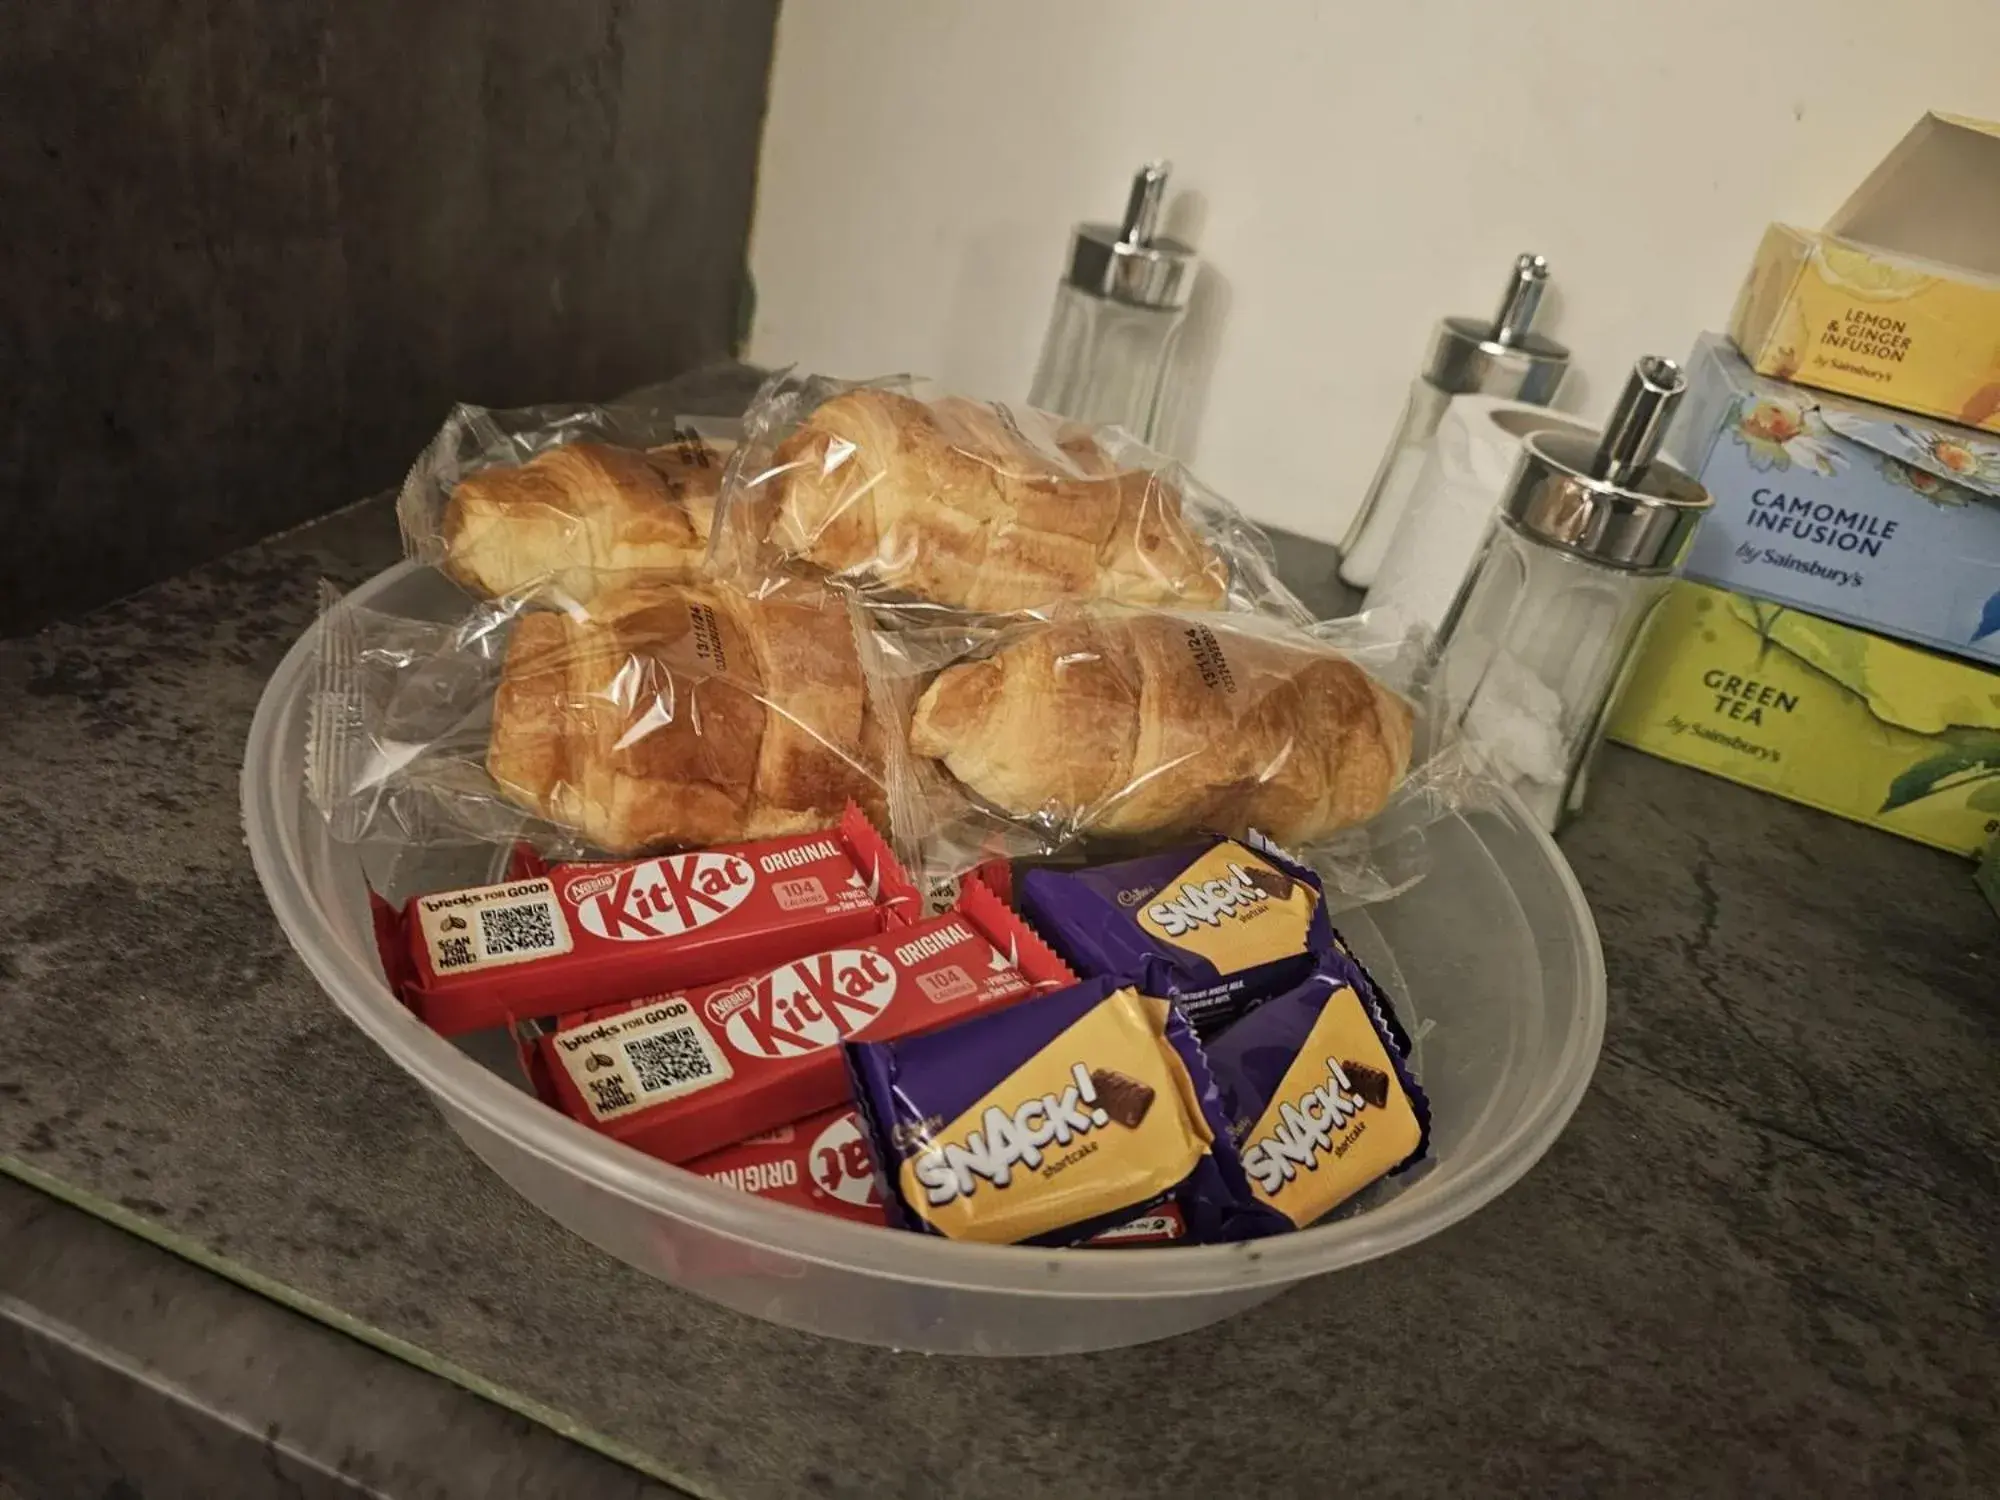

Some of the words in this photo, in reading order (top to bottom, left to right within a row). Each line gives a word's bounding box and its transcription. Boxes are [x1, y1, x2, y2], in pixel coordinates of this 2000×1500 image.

[1827, 319, 1841, 333] &
[1846, 323, 1912, 350] GINGER
[1844, 307, 1907, 334] LEMON
[1820, 331, 1905, 363] INFUSION
[1746, 508, 1884, 558] INFUSION
[1751, 487, 1898, 540] CAMOMILE
[1735, 540, 1761, 565] by
[1764, 548, 1865, 588] Sainsbury's
[1184, 628, 1219, 689] 13/11/24
[1702, 668, 1799, 713] GREEN
[1713, 696, 1763, 727] TEA
[1665, 714, 1688, 736] by
[1691, 721, 1782, 764] Sainsbury's
[759, 840, 842, 874] ORIGINAL
[422, 893, 482, 912] breaks
[484, 891, 506, 901] FOR
[507, 882, 550, 898] GOOD
[594, 854, 749, 939] KitKat
[782, 880, 815, 897] 104
[1148, 863, 1268, 937] SNACK!
[437, 936, 471, 950] SCAN
[894, 922, 975, 968] ORIGINAL
[924, 970, 961, 989] 104
[559, 1025, 620, 1052] breaks
[621, 1017, 645, 1032] FOR
[645, 1002, 688, 1026] GOOD
[738, 953, 890, 1056] KitKat
[588, 1073, 625, 1094] SCAN
[914, 1062, 1110, 1208] SNACK!
[1242, 1055, 1367, 1197] SNACK!
[1042, 1141, 1099, 1180] shortcake
